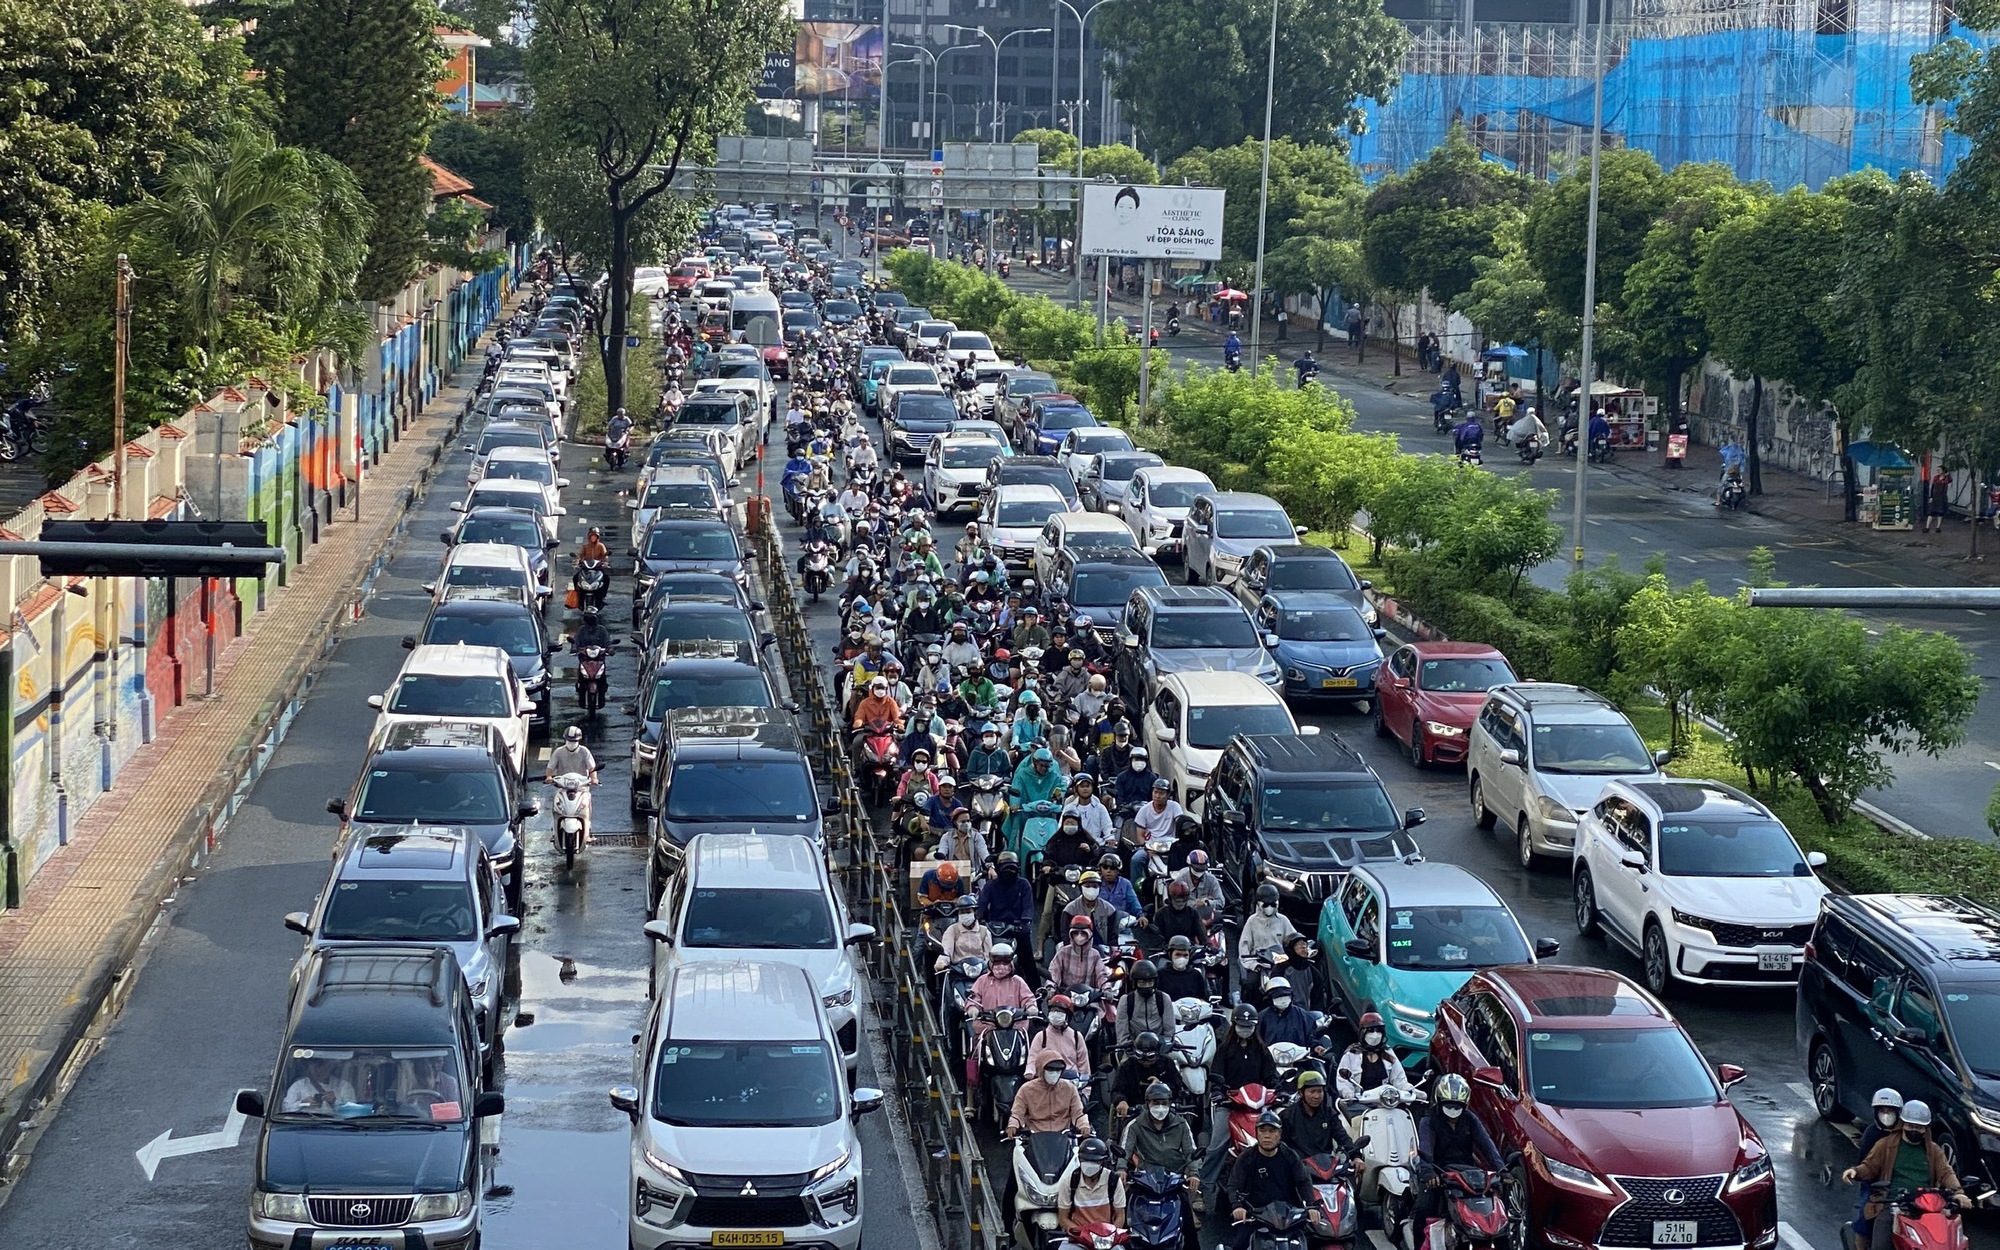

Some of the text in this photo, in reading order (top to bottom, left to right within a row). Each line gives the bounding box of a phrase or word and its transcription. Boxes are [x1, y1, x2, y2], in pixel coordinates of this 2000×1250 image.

[1162, 209, 1202, 217] AESTHETIC
[1157, 225, 1205, 237] TỎA SÁNG
[1157, 236, 1172, 244] ĐẸP
[1173, 236, 1193, 244] ĐÍCH
[1194, 237, 1215, 246] THỰC
[1762, 954, 1789, 962] 41-416
[1763, 962, 1787, 970] NN-36
[1665, 1223, 1686, 1233] 51H
[1658, 1233, 1693, 1243] 474.10
